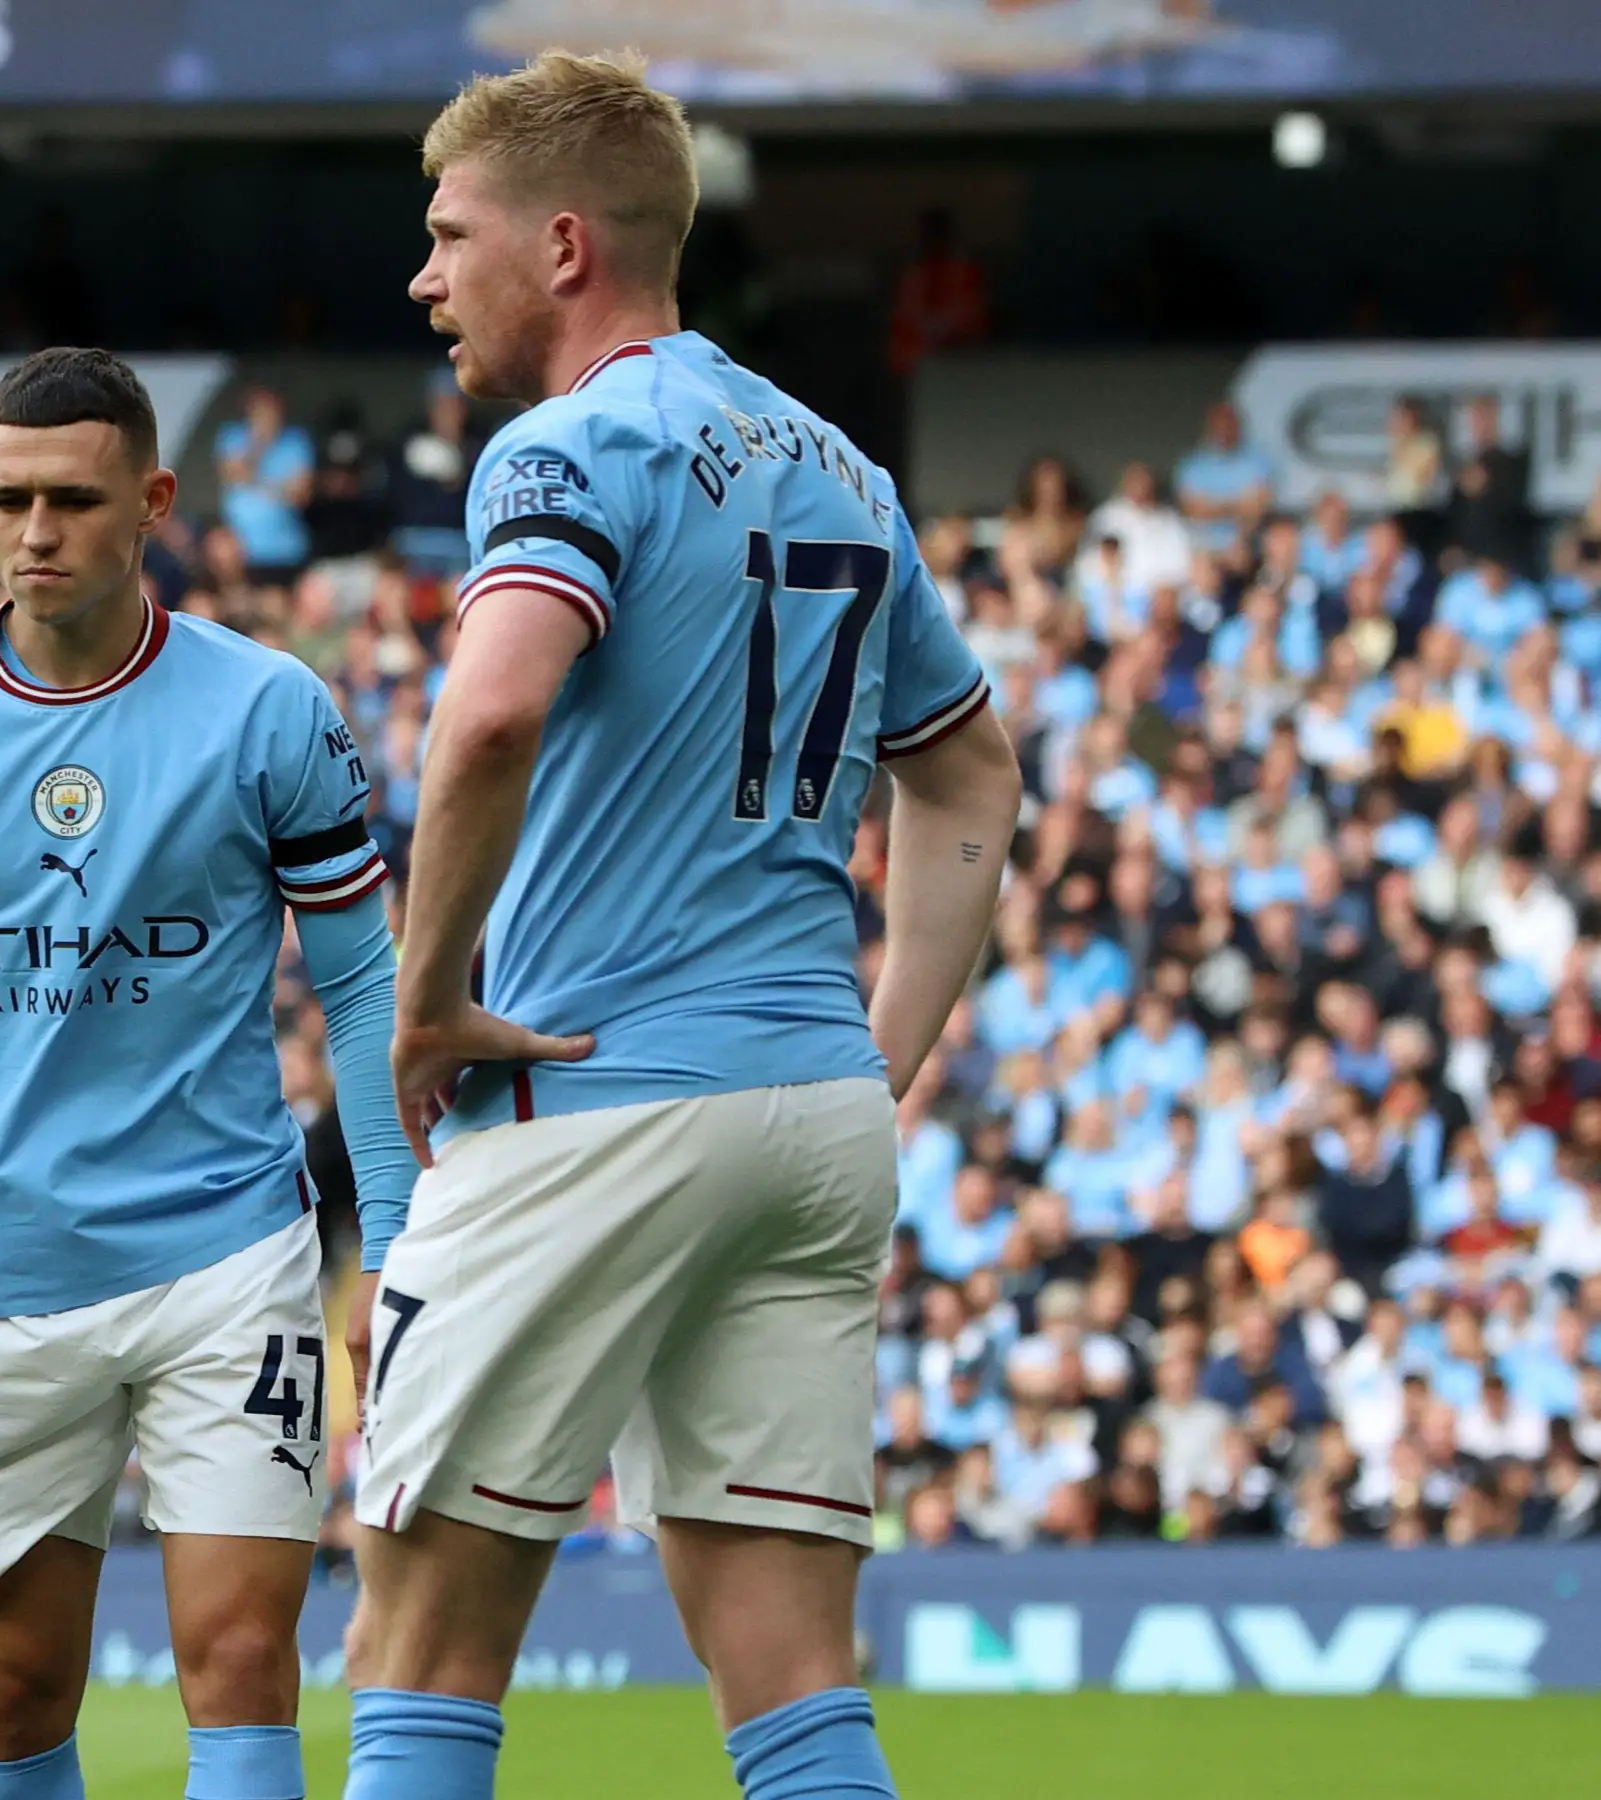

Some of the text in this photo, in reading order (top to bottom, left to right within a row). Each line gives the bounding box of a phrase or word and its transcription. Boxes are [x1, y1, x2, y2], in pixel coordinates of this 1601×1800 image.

[690, 423, 745, 511] DE
[482, 486, 568, 528] TIRE
[732, 527, 893, 822] 17
[39, 770, 98, 794] MANCHESTER
[60, 826, 81, 835] CITY
[244, 1335, 325, 1441] 47
